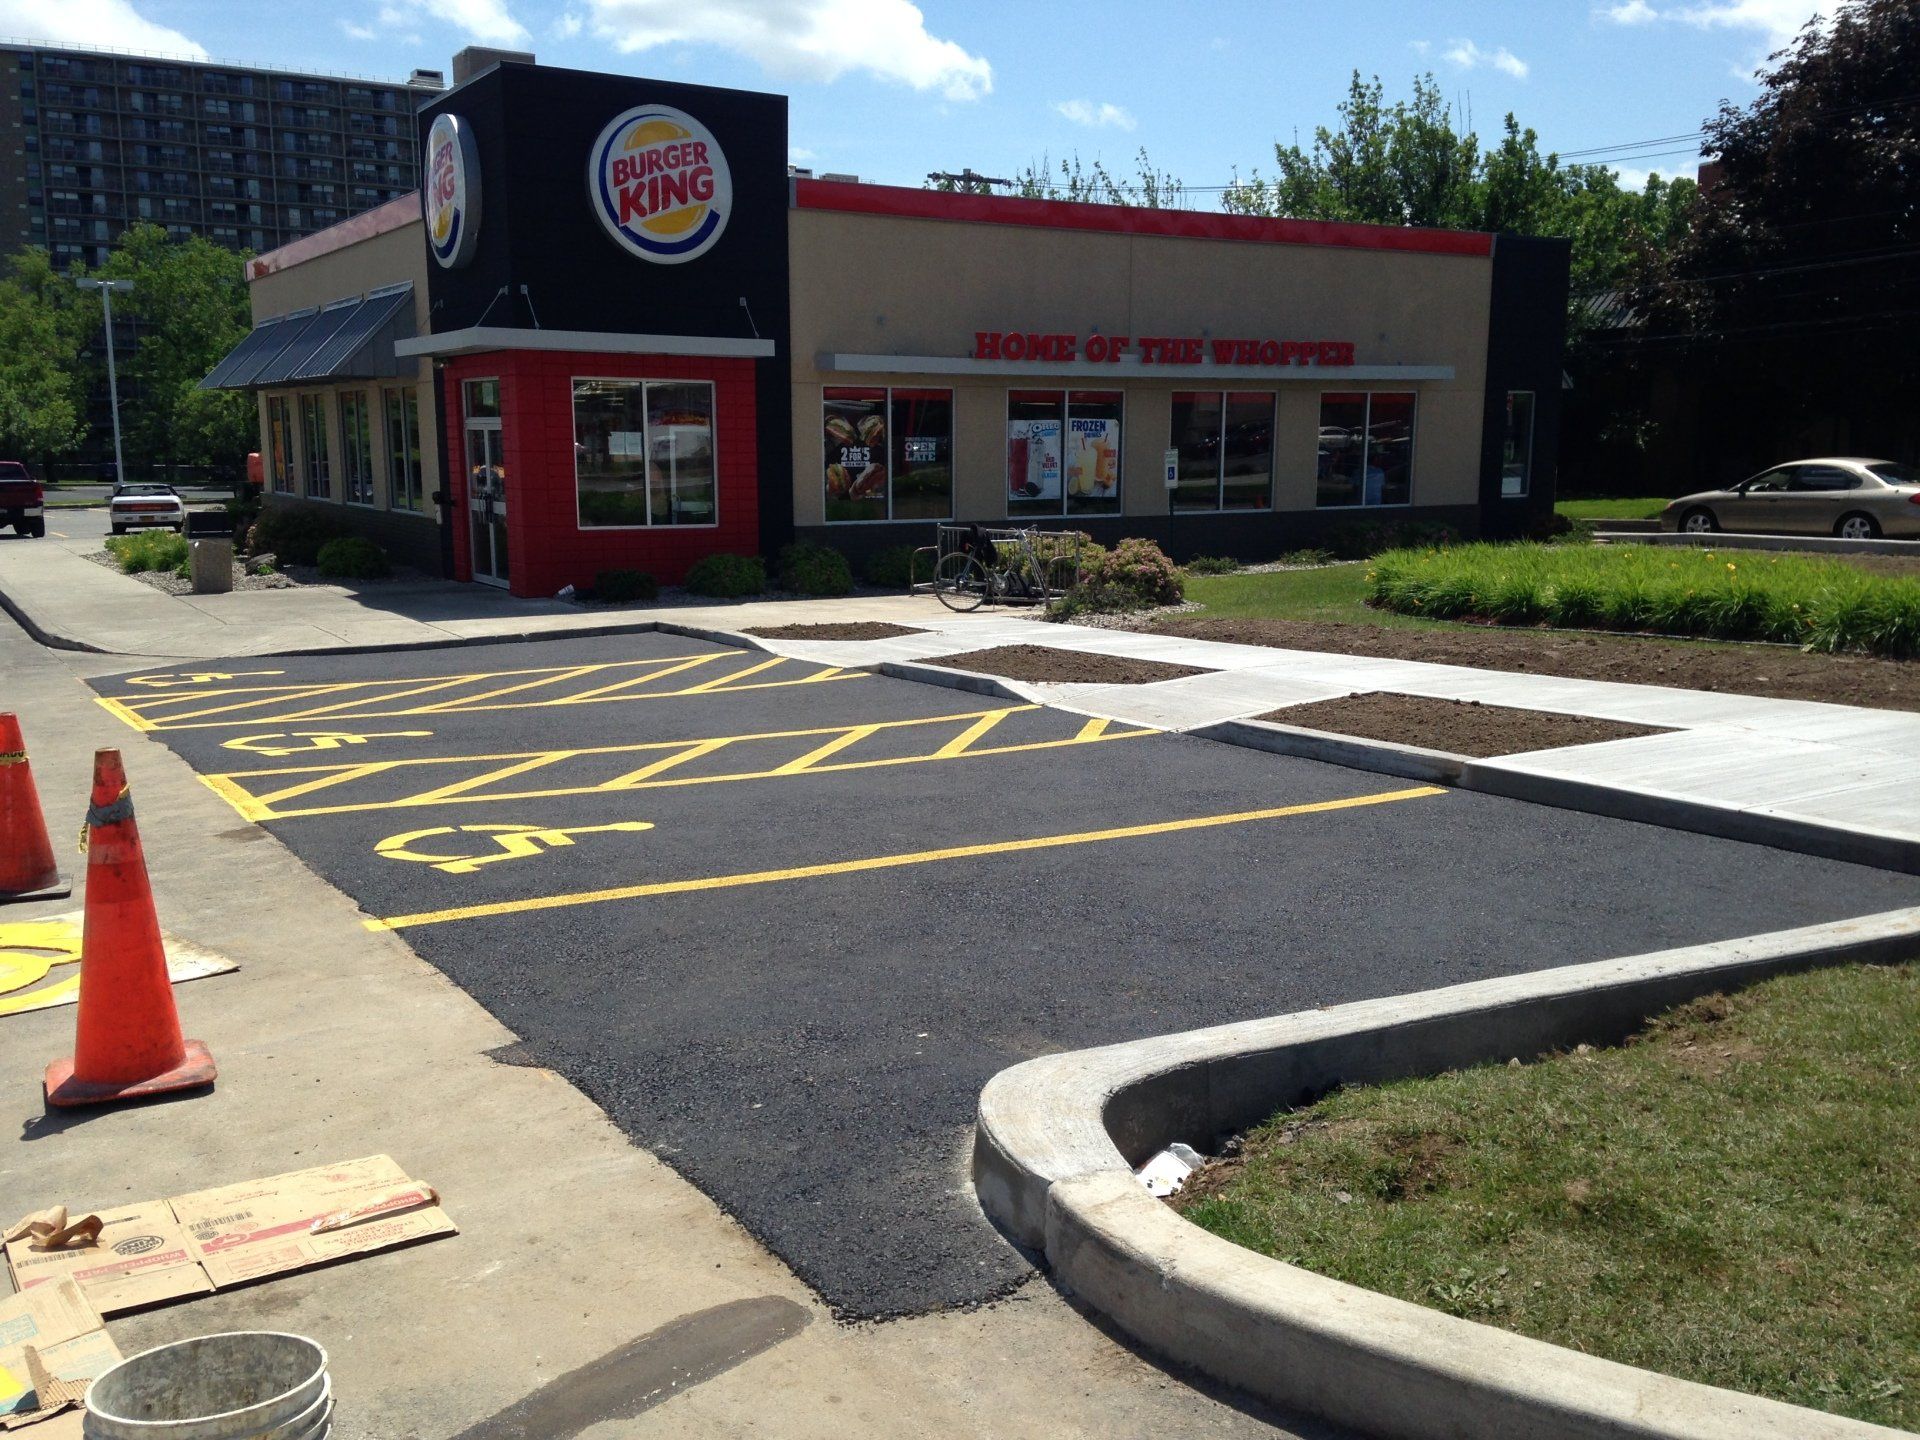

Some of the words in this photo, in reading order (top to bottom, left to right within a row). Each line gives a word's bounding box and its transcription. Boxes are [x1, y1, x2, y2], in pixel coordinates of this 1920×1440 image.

[612, 141, 709, 188] BURGER
[618, 166, 714, 227] KING
[975, 331, 1076, 362] HOME
[1085, 334, 1130, 363] OF
[1138, 337, 1203, 365] THE
[1211, 339, 1355, 367] WHOPPER
[1072, 420, 1106, 432] FROZEN
[840, 446, 848, 461] 2
[848, 452, 862, 461] FOR
[904, 442, 936, 452] OPEN
[904, 451, 936, 462] LATE
[119, 1251, 182, 1269] WHOPPER
